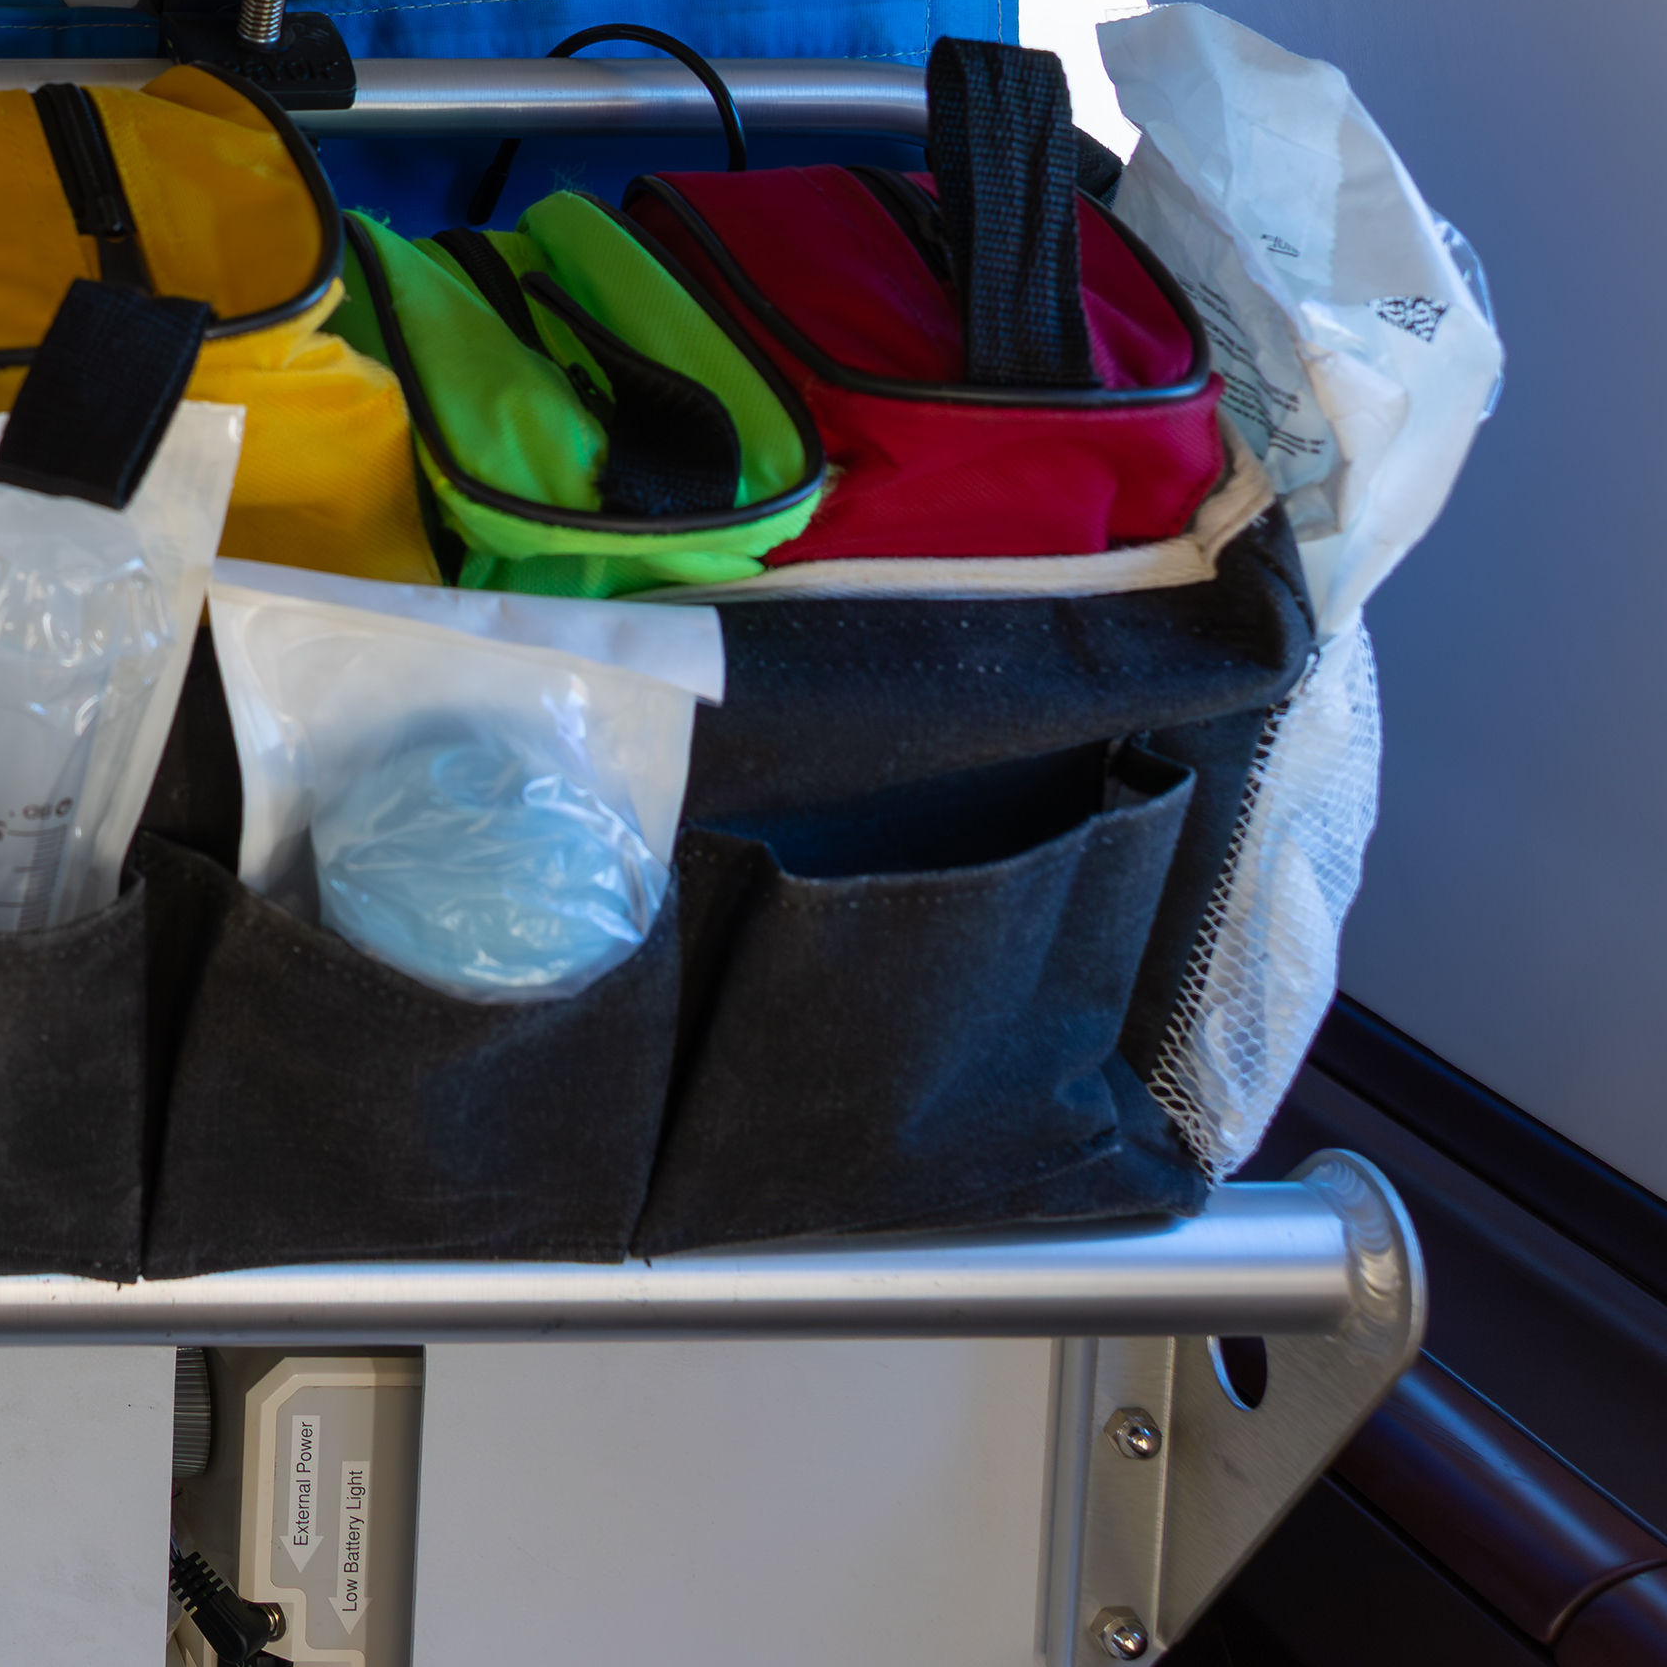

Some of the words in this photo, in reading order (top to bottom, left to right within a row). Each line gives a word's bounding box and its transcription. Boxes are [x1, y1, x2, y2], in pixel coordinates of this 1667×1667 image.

[296, 1421, 314, 1473] Power
[293, 1479, 311, 1546] External
[346, 1470, 366, 1510] Light
[343, 1515, 365, 1573] Battery
[342, 1578, 358, 1612] Low
